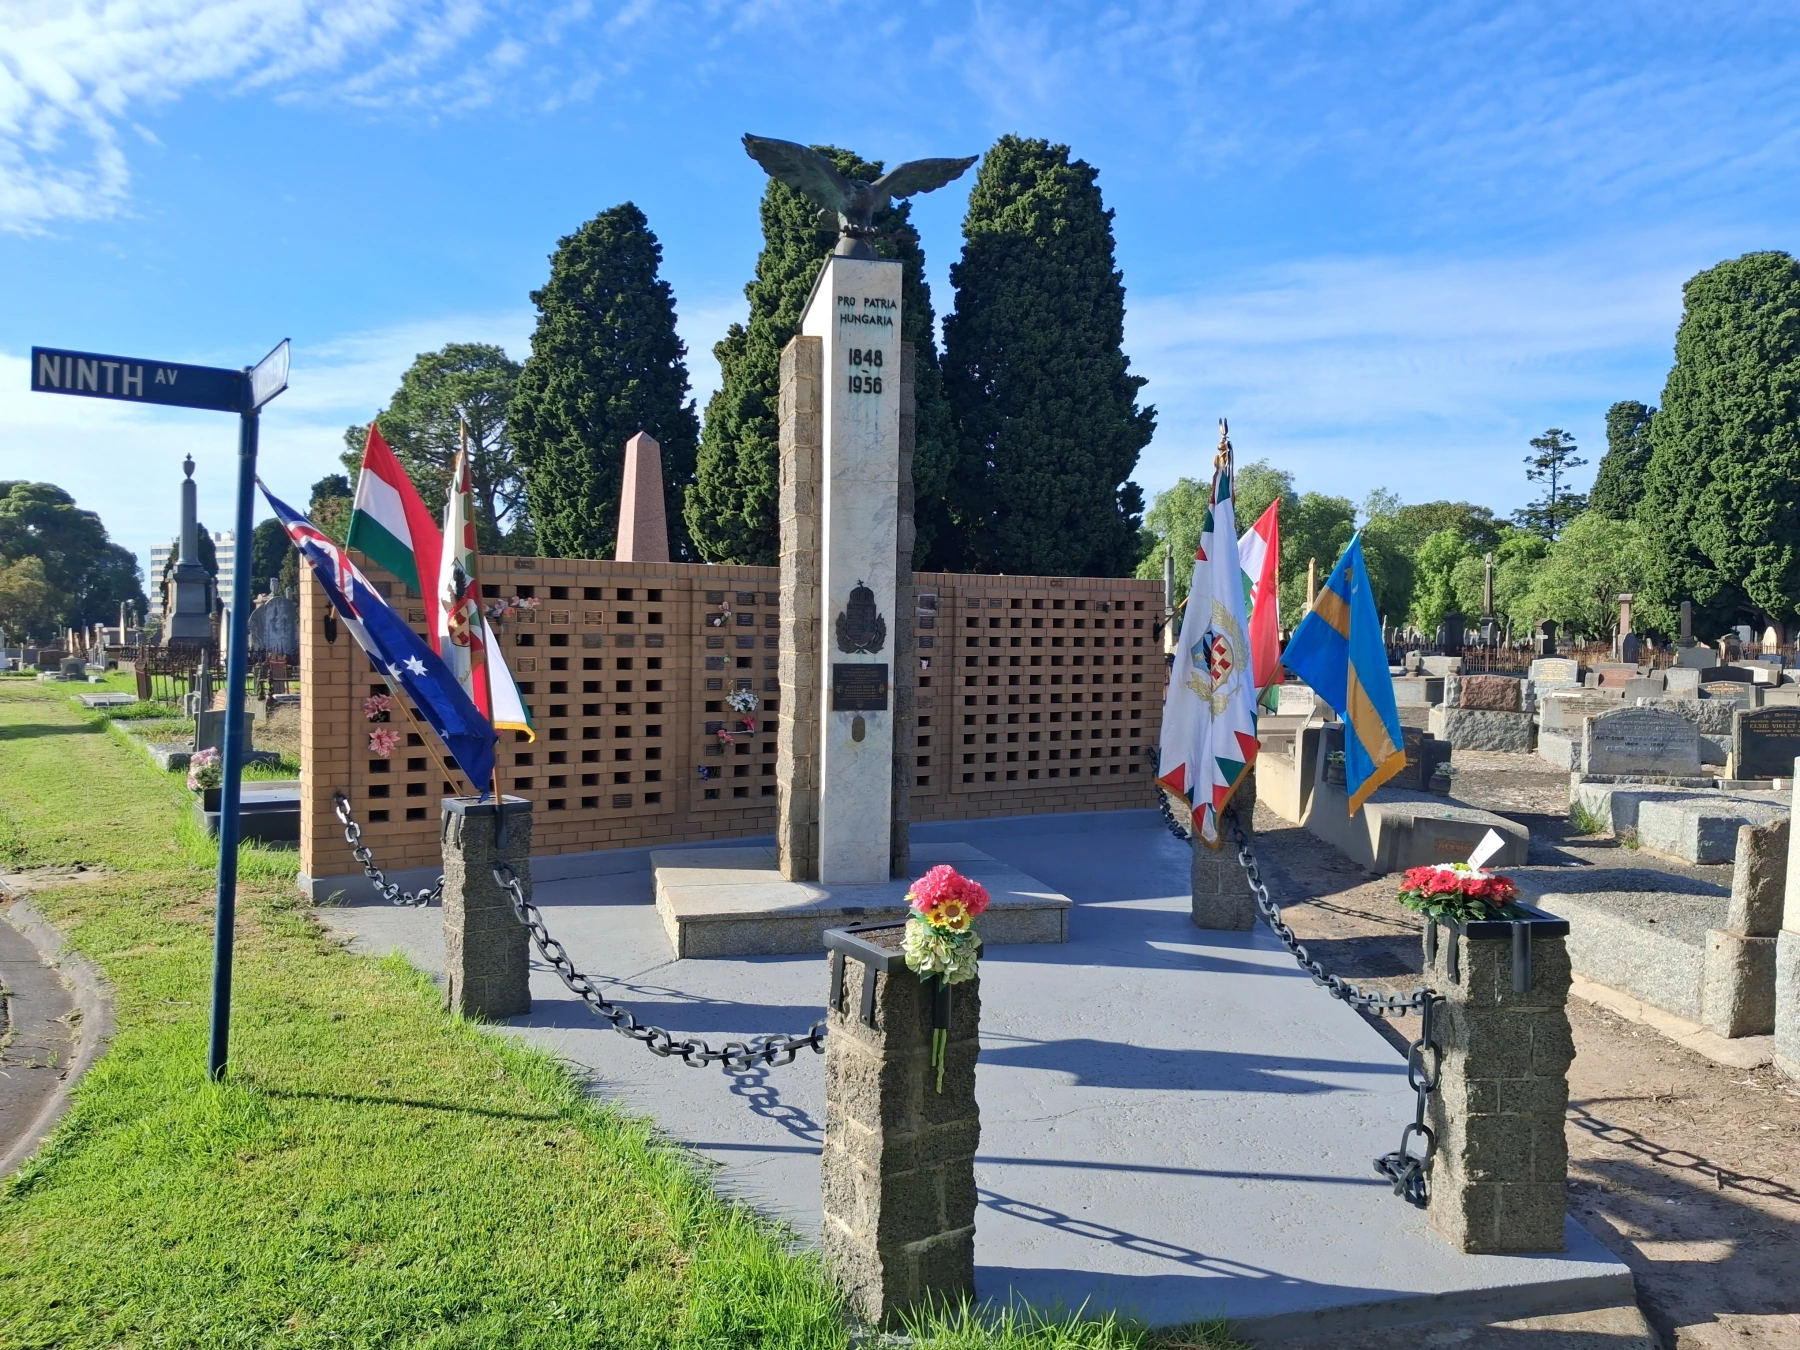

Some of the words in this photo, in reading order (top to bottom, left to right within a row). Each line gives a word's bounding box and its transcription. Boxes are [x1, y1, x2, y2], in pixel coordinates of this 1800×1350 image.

[837, 296, 856, 307] PRO
[864, 297, 897, 309] PATRIA
[839, 313, 893, 326] HUNGARIA
[848, 348, 883, 367] 1848
[39, 354, 144, 397] NINTH
[155, 368, 178, 386] AV
[848, 376, 883, 394] 1956
